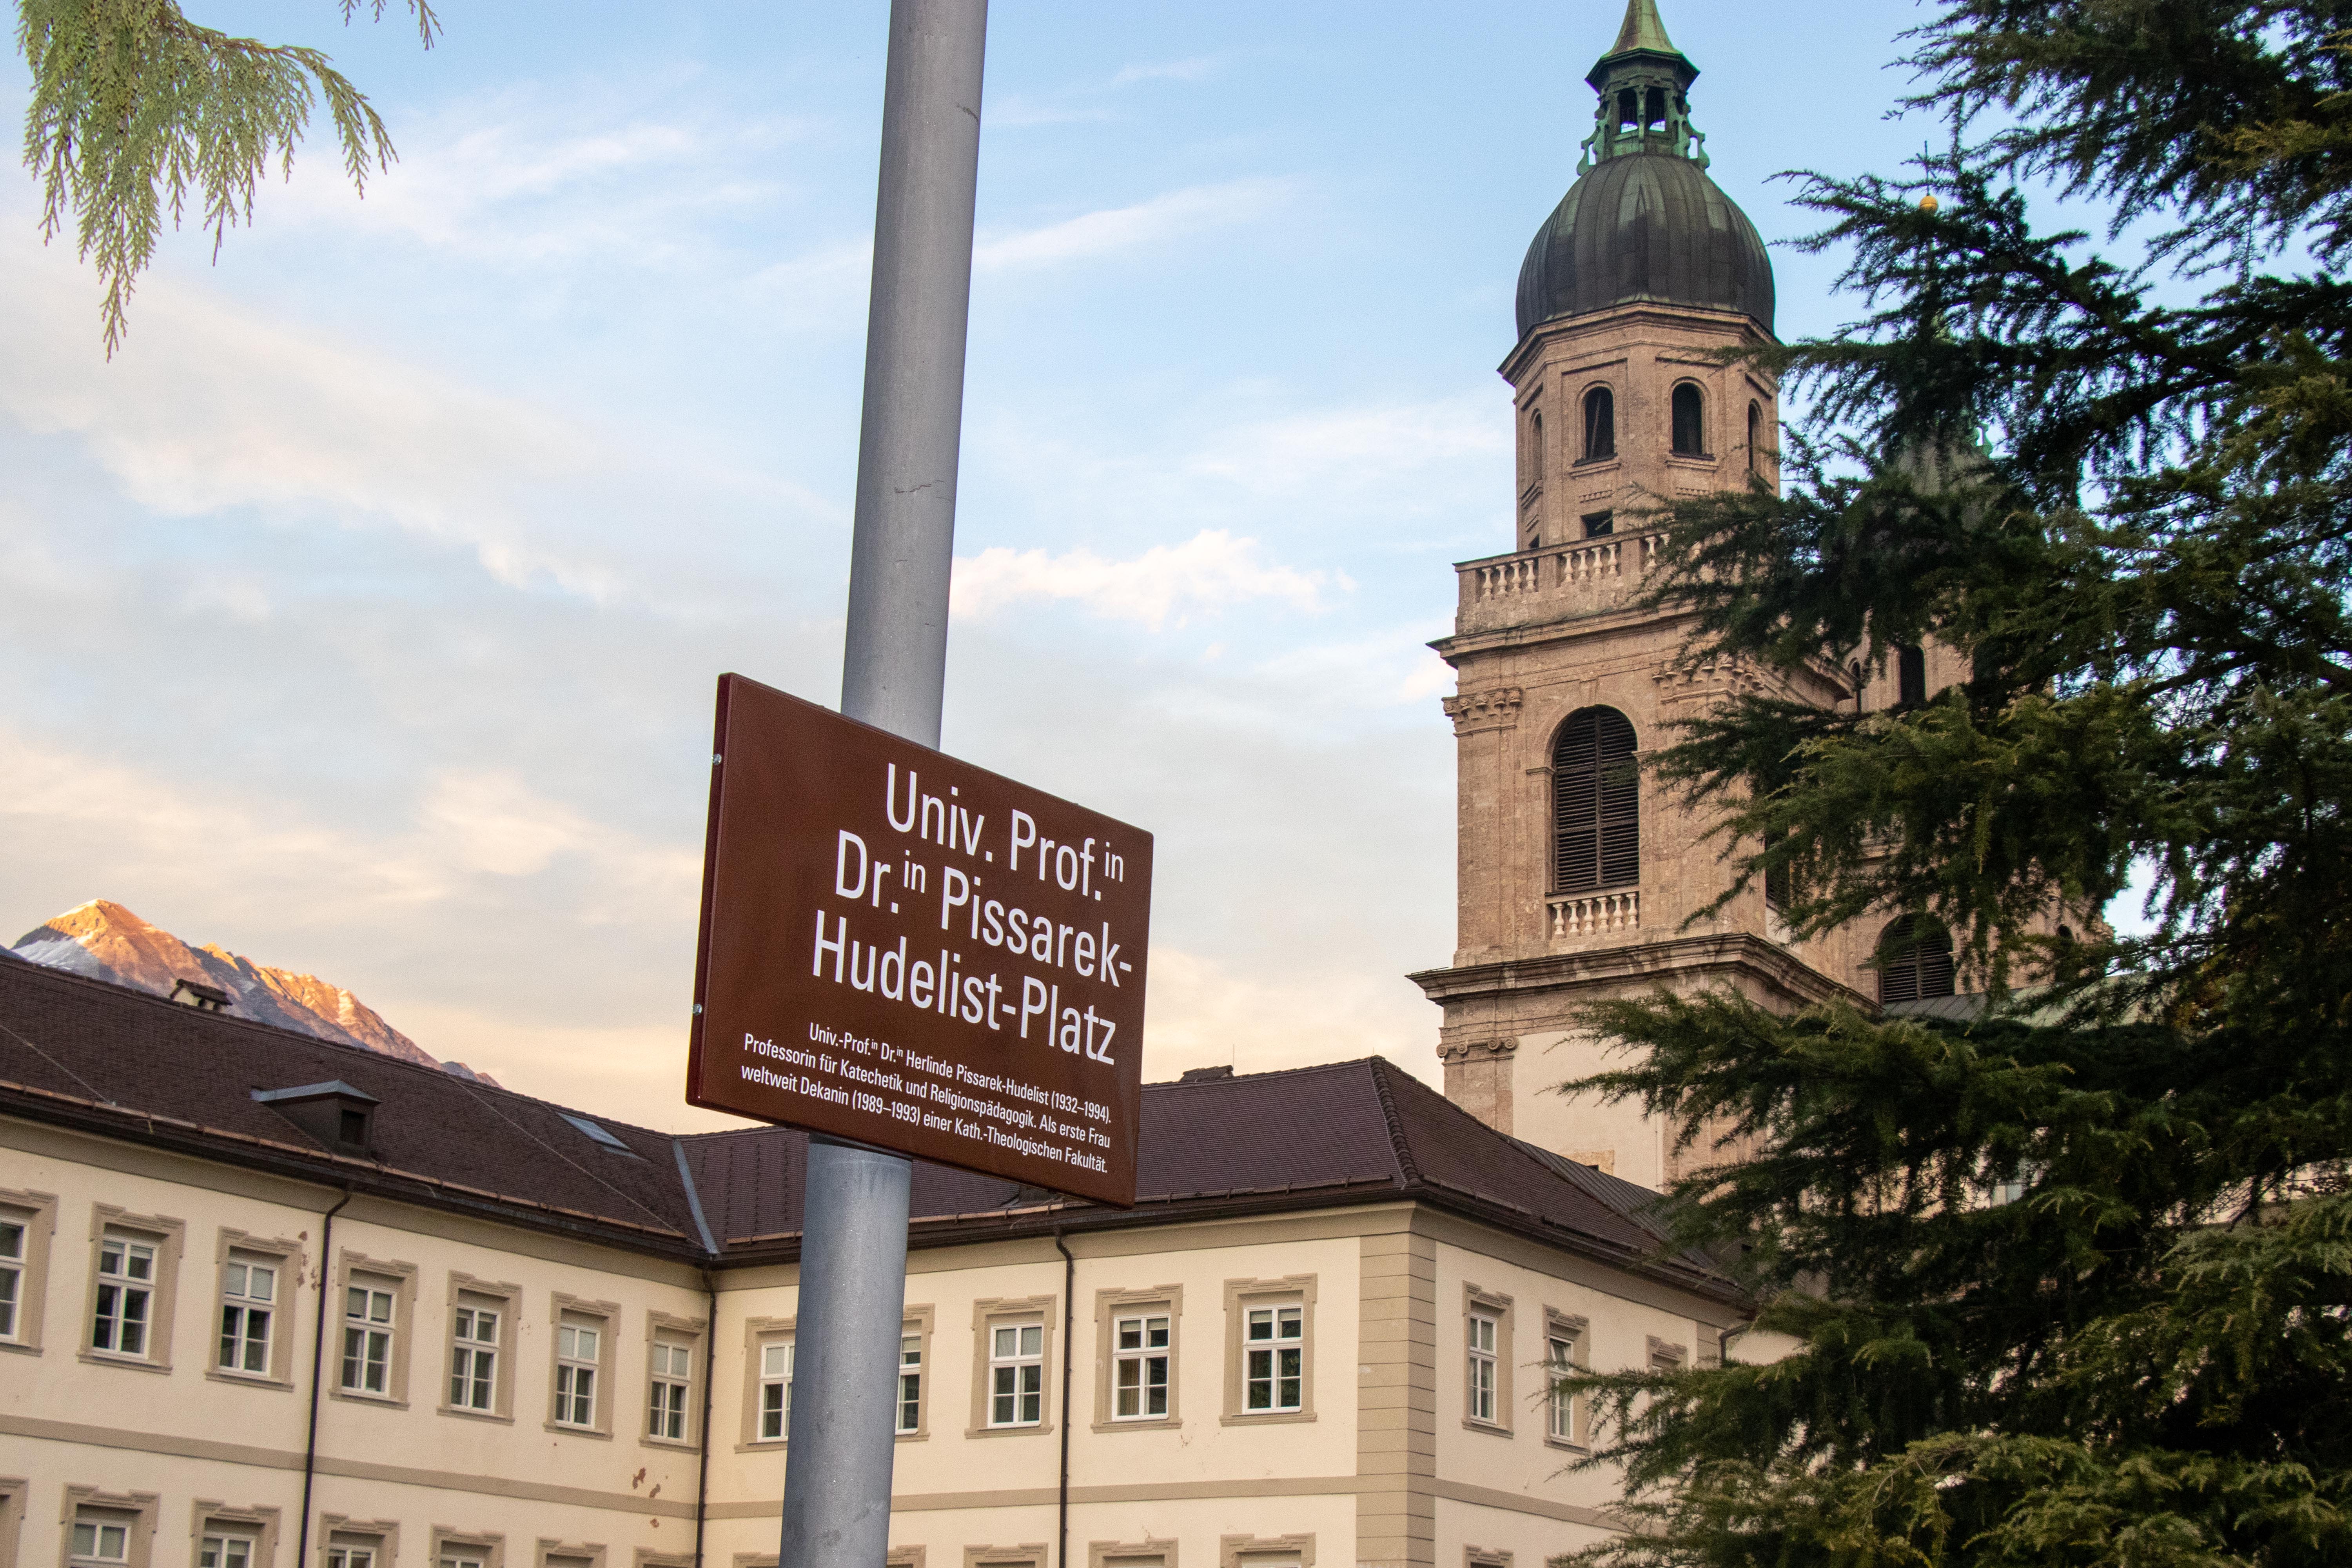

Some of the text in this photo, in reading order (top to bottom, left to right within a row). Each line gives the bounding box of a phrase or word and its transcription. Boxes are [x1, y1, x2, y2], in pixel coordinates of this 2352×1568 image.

[886, 762, 993, 862] Univ.
[941, 866, 1132, 987] Pissarek-
[813, 909, 1116, 1065] Hudelist-Platz
[741, 1065, 797, 1092] weltweit
[800, 1076, 849, 1105] Dekanin
[923, 1111, 952, 1132] einer
[955, 1117, 1062, 1161] Kath.-Theologischen
[1065, 1147, 1107, 1173] Fakultät.
[744, 1033, 1110, 1148] Professorin für Katechetik und Religionspädagogik. Als erste Frau
[906, 1049, 953, 1078] Herlinde
[956, 1063, 1049, 1105] Pissarek-Hudelist
